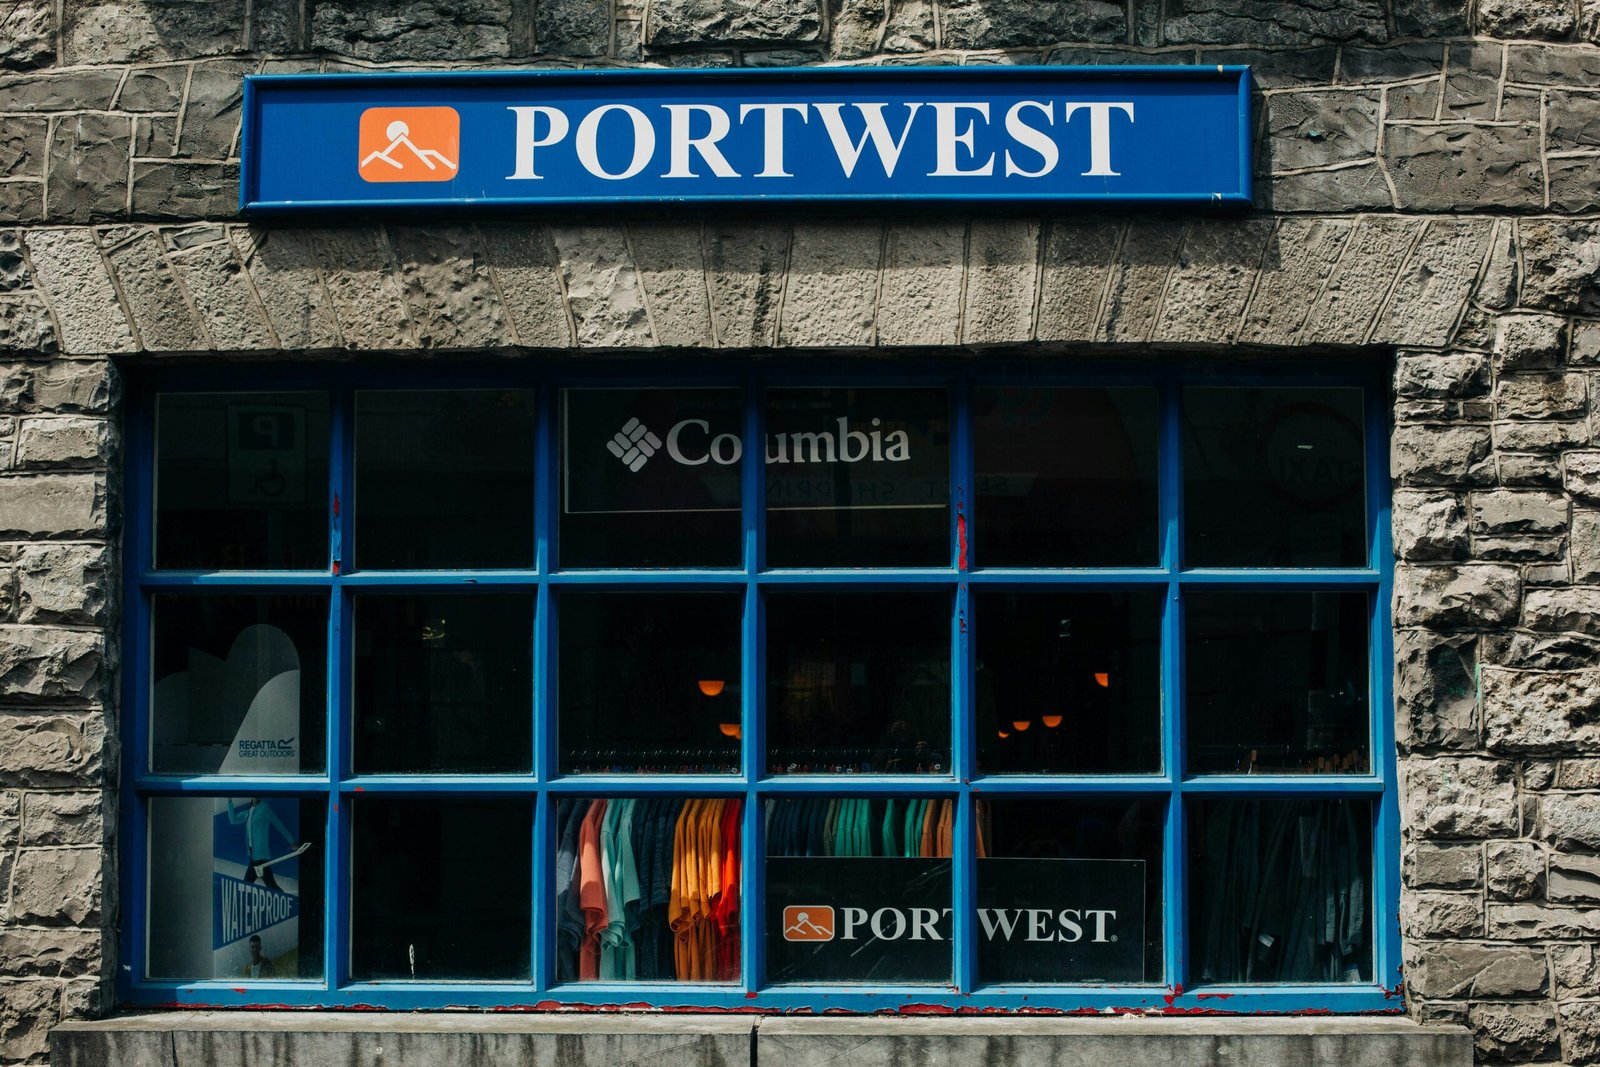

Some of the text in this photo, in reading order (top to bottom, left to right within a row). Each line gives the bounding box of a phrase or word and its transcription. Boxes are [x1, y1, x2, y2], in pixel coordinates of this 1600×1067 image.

[505, 100, 1135, 181] PORTWEST
[666, 416, 911, 466] Coumbia
[239, 740, 277, 750] REGATTA
[239, 750, 258, 758] GREAT
[221, 877, 294, 944] WATERPROOF
